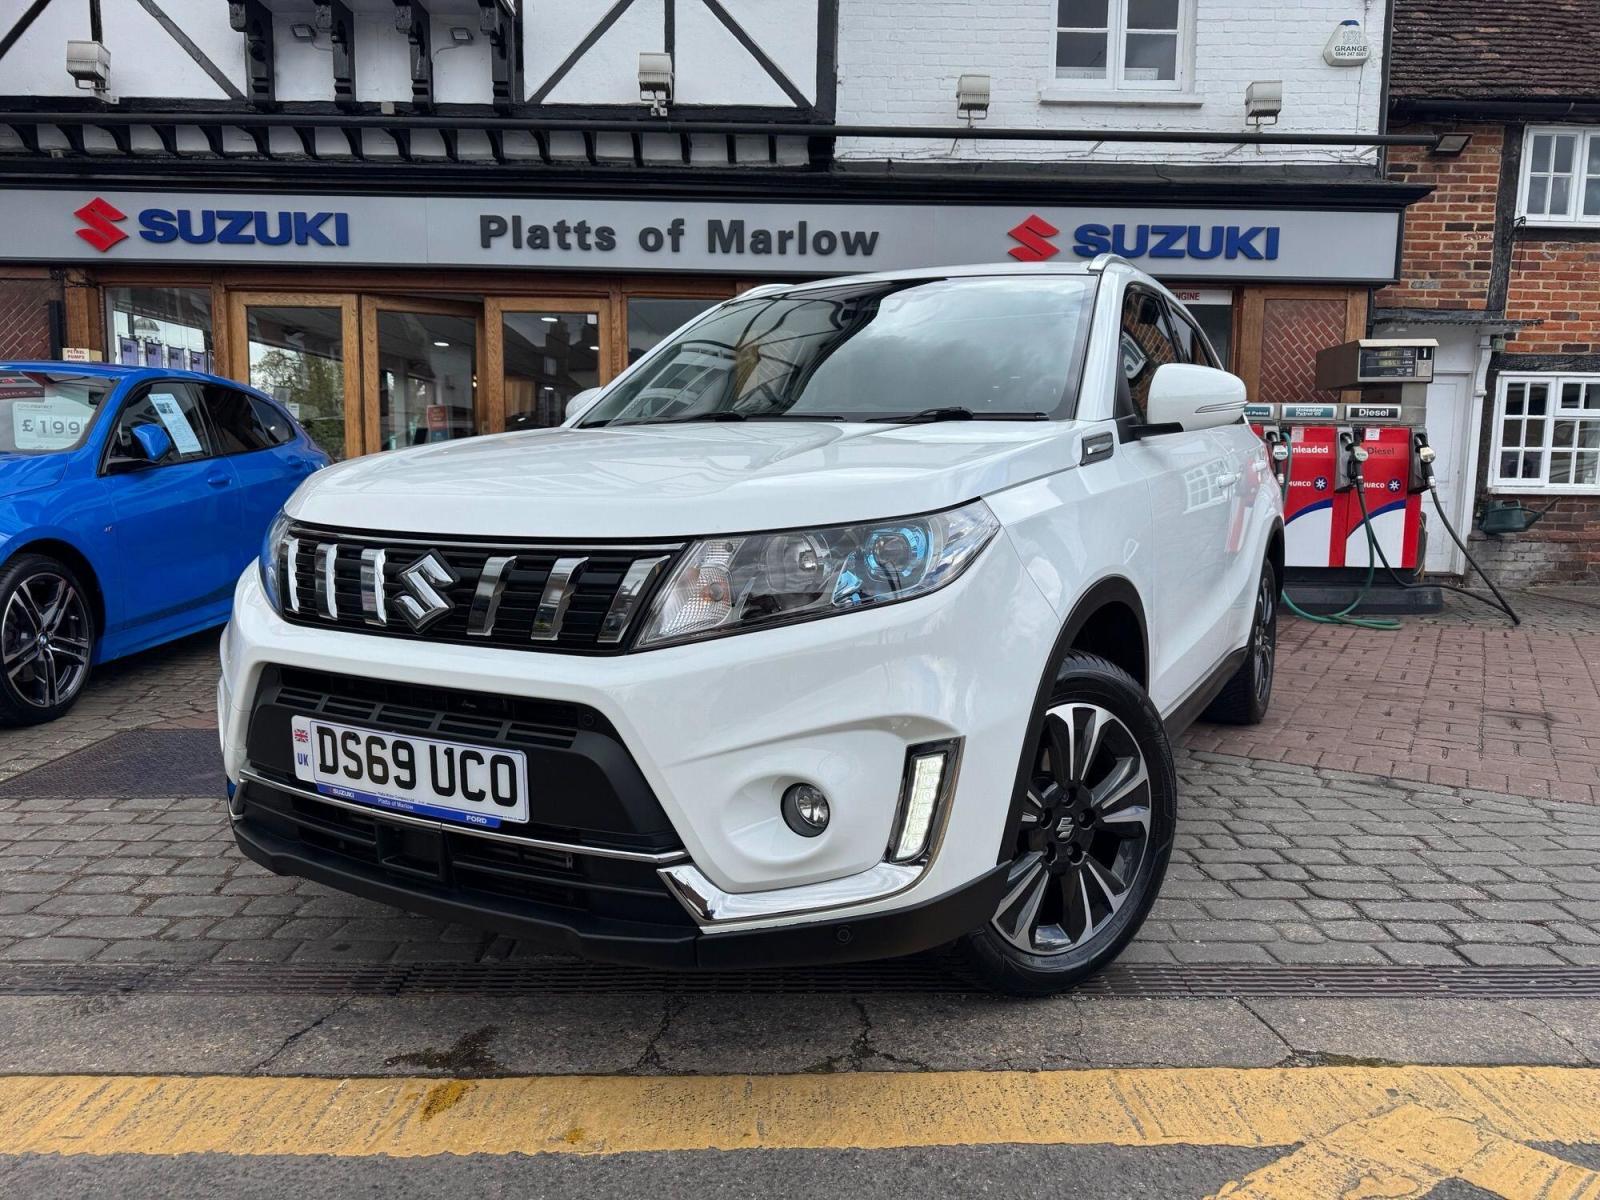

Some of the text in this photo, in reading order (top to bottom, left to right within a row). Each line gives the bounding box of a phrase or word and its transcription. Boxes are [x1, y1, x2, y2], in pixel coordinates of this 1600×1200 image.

[138, 208, 349, 246] SUZUKI
[479, 214, 880, 257] Platts of Marlow
[1072, 223, 1281, 261] SUZUKI
[1174, 292, 1200, 300] NGINE
[1422, 347, 1427, 358] 1
[1358, 408, 1389, 417] Diesel
[1367, 446, 1395, 455] Diesel
[297, 752, 309, 767] UK
[316, 725, 518, 808] DS69 UCO
[332, 788, 355, 799] SUZUKI
[377, 797, 391, 806] Platts
[396, 801, 414, 810] Marlow
[465, 815, 488, 825] FORD
